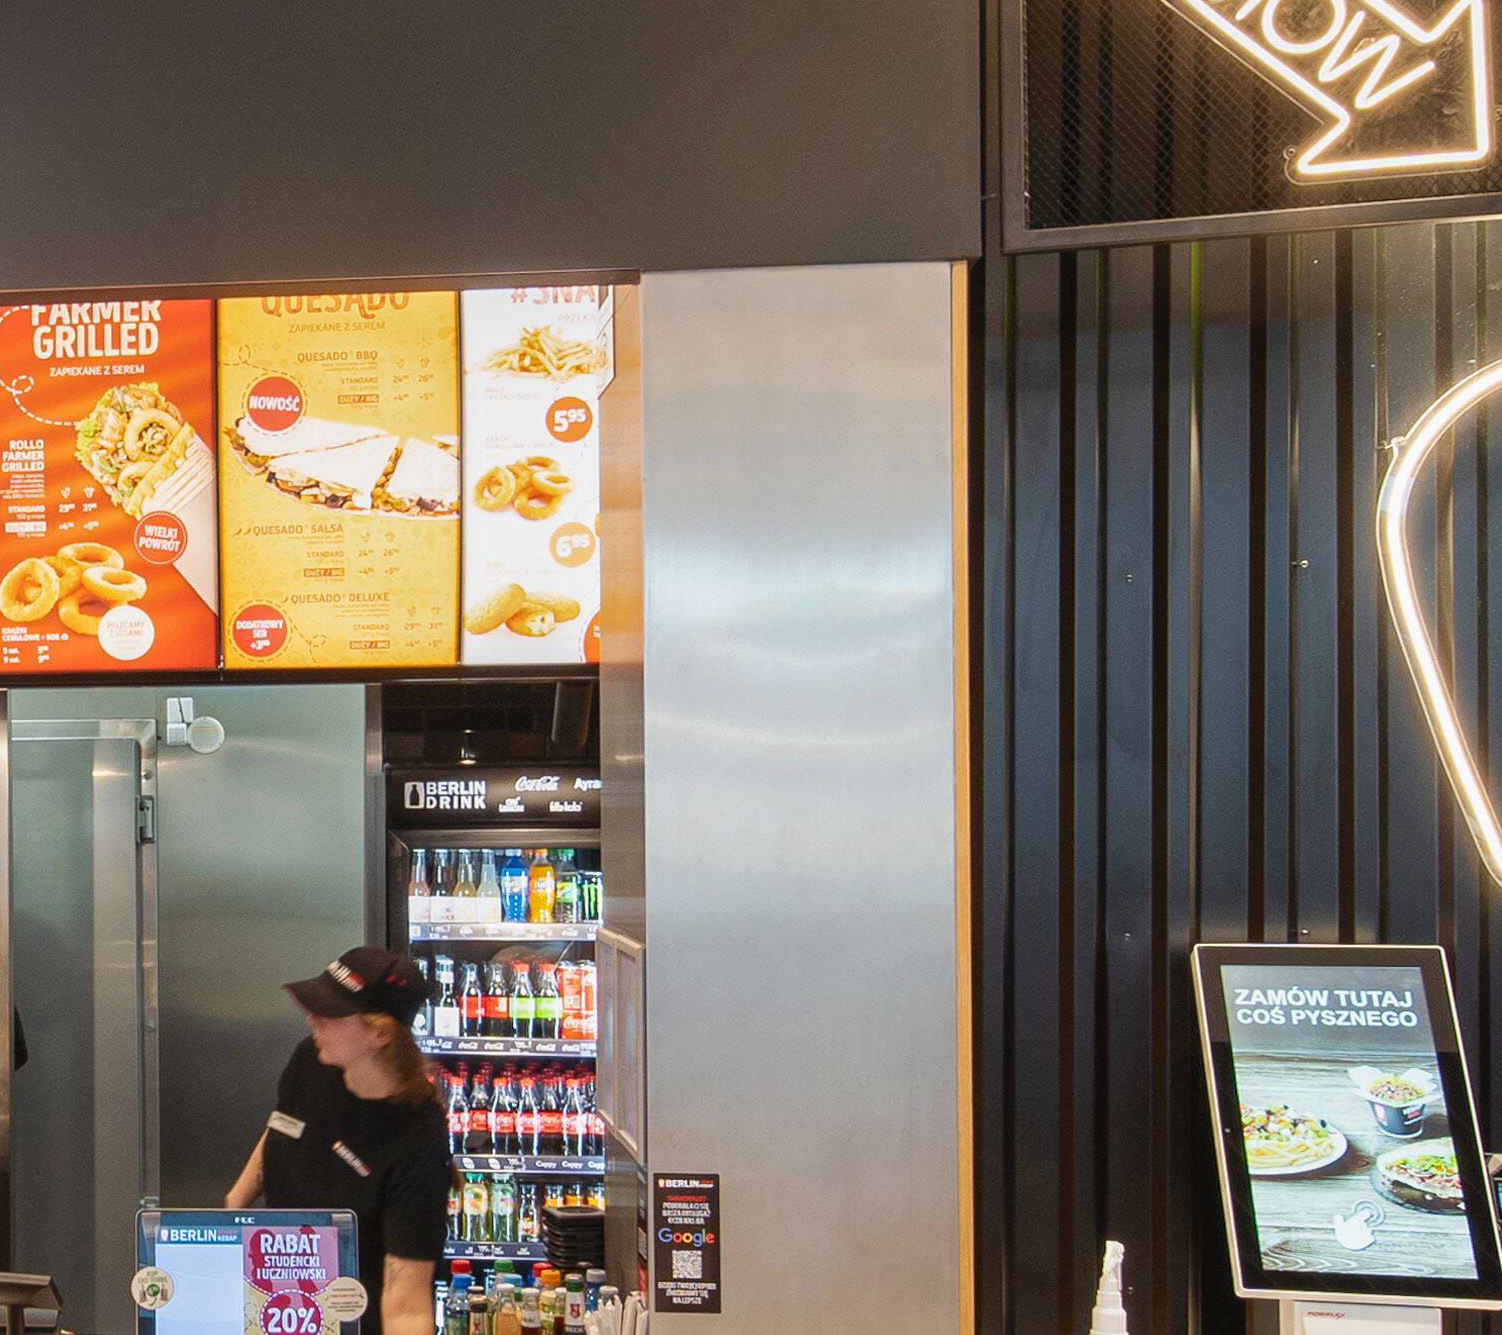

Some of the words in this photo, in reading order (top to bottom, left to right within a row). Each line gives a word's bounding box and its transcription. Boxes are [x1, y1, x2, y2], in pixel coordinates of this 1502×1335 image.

[289, 323, 341, 333] ZAPIEKANE
[343, 323, 350, 331] Z
[353, 322, 386, 331] SEREM
[33, 322, 159, 360] GRILLED
[356, 351, 378, 361] BBQ
[50, 366, 102, 377] ZAPIEKANE
[103, 366, 110, 375] Z
[112, 364, 145, 375] SEREM
[249, 394, 299, 412] NOWOŚĆ
[9, 440, 44, 450] ROLLO
[2, 451, 44, 461] FARMER
[2, 461, 44, 472] GRILLED
[145, 525, 178, 540] WIELKI
[310, 524, 343, 534] SALSA
[139, 536, 181, 552] POWRÓT
[306, 550, 344, 558] STANDARD
[349, 592, 390, 602] DELUXE
[236, 619, 284, 630] DODATKOWY
[252, 630, 267, 638] SER
[425, 781, 486, 795] BERLIN
[425, 796, 486, 809] DRINK
[1234, 986, 1328, 1006] ZAMÓW
[1334, 991, 1412, 1008] TUTAJ
[1237, 1007, 1285, 1024] COŚ
[1292, 1010, 1418, 1027] PYSZNEGO
[665, 1179, 700, 1188] BERLIN
[170, 1229, 217, 1242] BERLIN
[658, 1227, 715, 1247] Google
[260, 1234, 321, 1254] RABAT
[264, 1256, 320, 1267] STUDENCKI
[262, 1268, 326, 1281] UCZNIOWSKI
[267, 1307, 318, 1334] 20%
